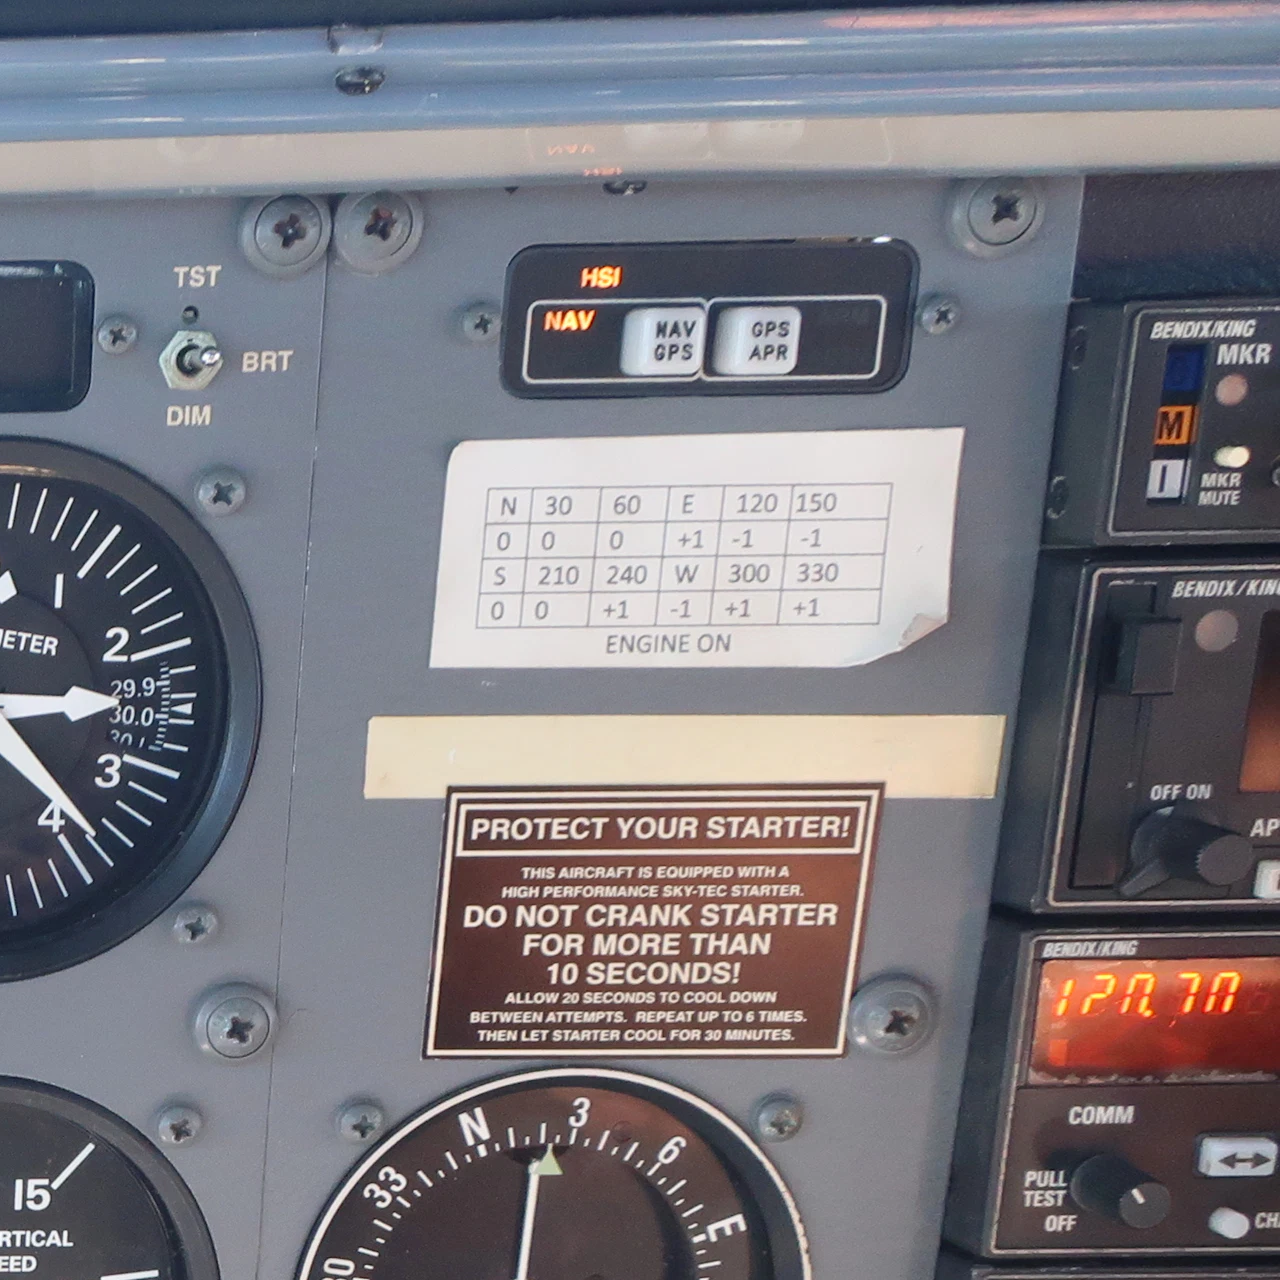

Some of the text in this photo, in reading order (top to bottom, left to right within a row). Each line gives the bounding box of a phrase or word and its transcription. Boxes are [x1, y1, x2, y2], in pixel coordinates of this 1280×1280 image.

[173, 264, 222, 288] TST
[581, 266, 621, 289] HSI
[544, 309, 595, 331] NAV
[655, 320, 697, 339] NAV
[751, 320, 790, 338] GPS
[241, 350, 294, 373] BRT
[654, 342, 694, 362] GPS
[748, 343, 788, 361] APR
[1216, 343, 1272, 365] MKR
[166, 404, 211, 427] DIM
[1201, 472, 1242, 488] MKR
[500, 492, 838, 516] N 30 60 E 120 150
[493, 562, 839, 586] S 210 240 W 300 330
[606, 633, 732, 655] ENGINE ON
[1150, 783, 1211, 801] OFF ON
[471, 815, 851, 841] PROTECT YOUR STARTER!
[521, 865, 790, 880] THIS AIRCRAFT IS EQUIPPED WITH A
[463, 903, 839, 928] DO NOT CRANK STARTER
[522, 932, 772, 956] FOR MORE THAN
[547, 961, 741, 985] 10 SECONDS!
[1069, 1105, 1134, 1125] COMM
[1024, 1170, 1068, 1188] PULL
[1023, 1190, 1067, 1208] TEST
[1044, 1214, 1077, 1232] OFF
